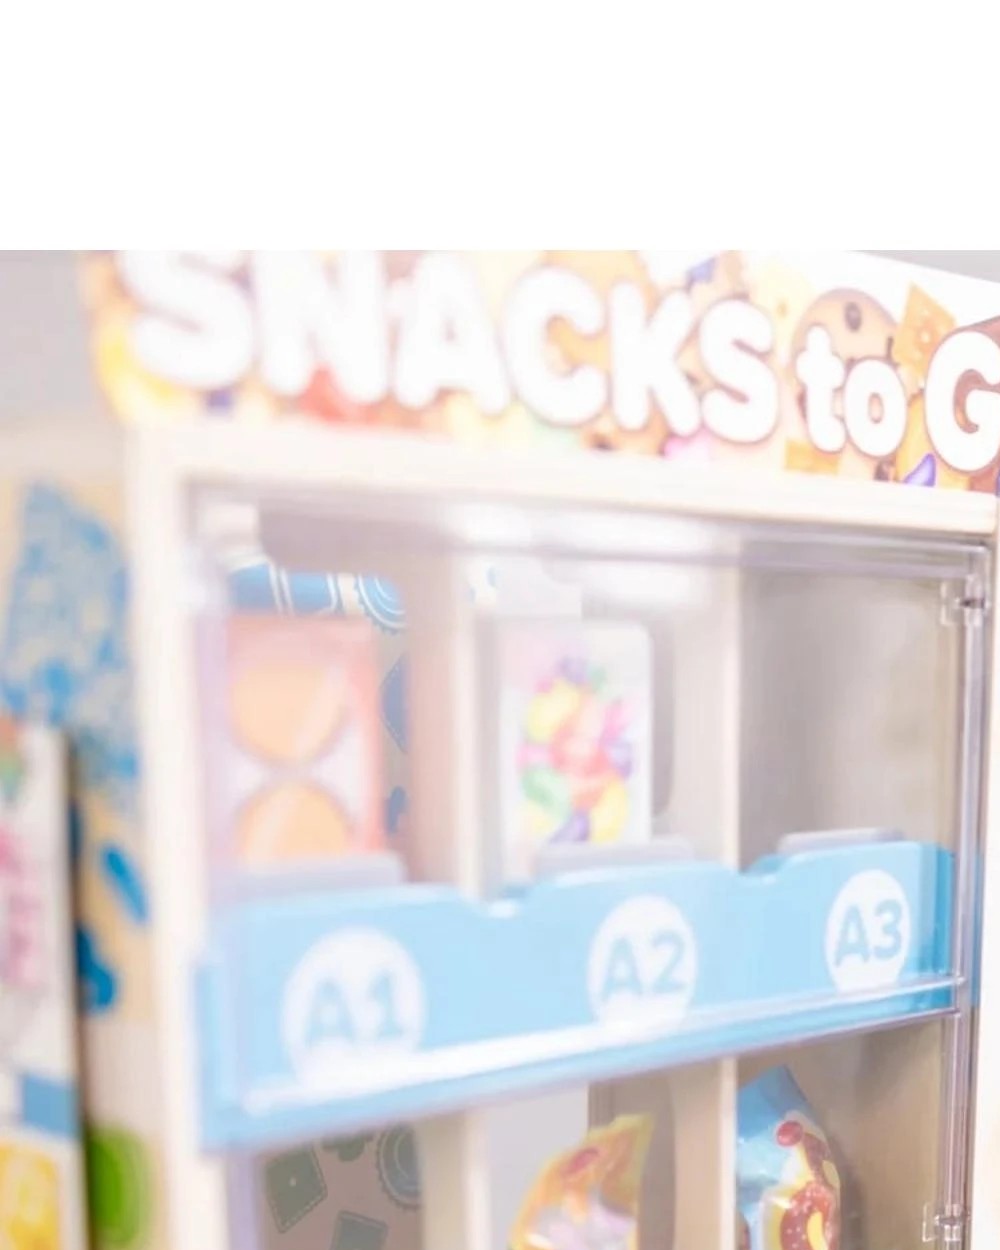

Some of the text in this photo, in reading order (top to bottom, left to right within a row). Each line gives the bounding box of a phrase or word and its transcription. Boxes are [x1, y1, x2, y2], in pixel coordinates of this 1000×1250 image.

[113, 250, 784, 447] SNACKS
[795, 324, 908, 458] to
[601, 929, 688, 995] A2
[834, 898, 904, 968] A3
[304, 968, 406, 1040] A1
